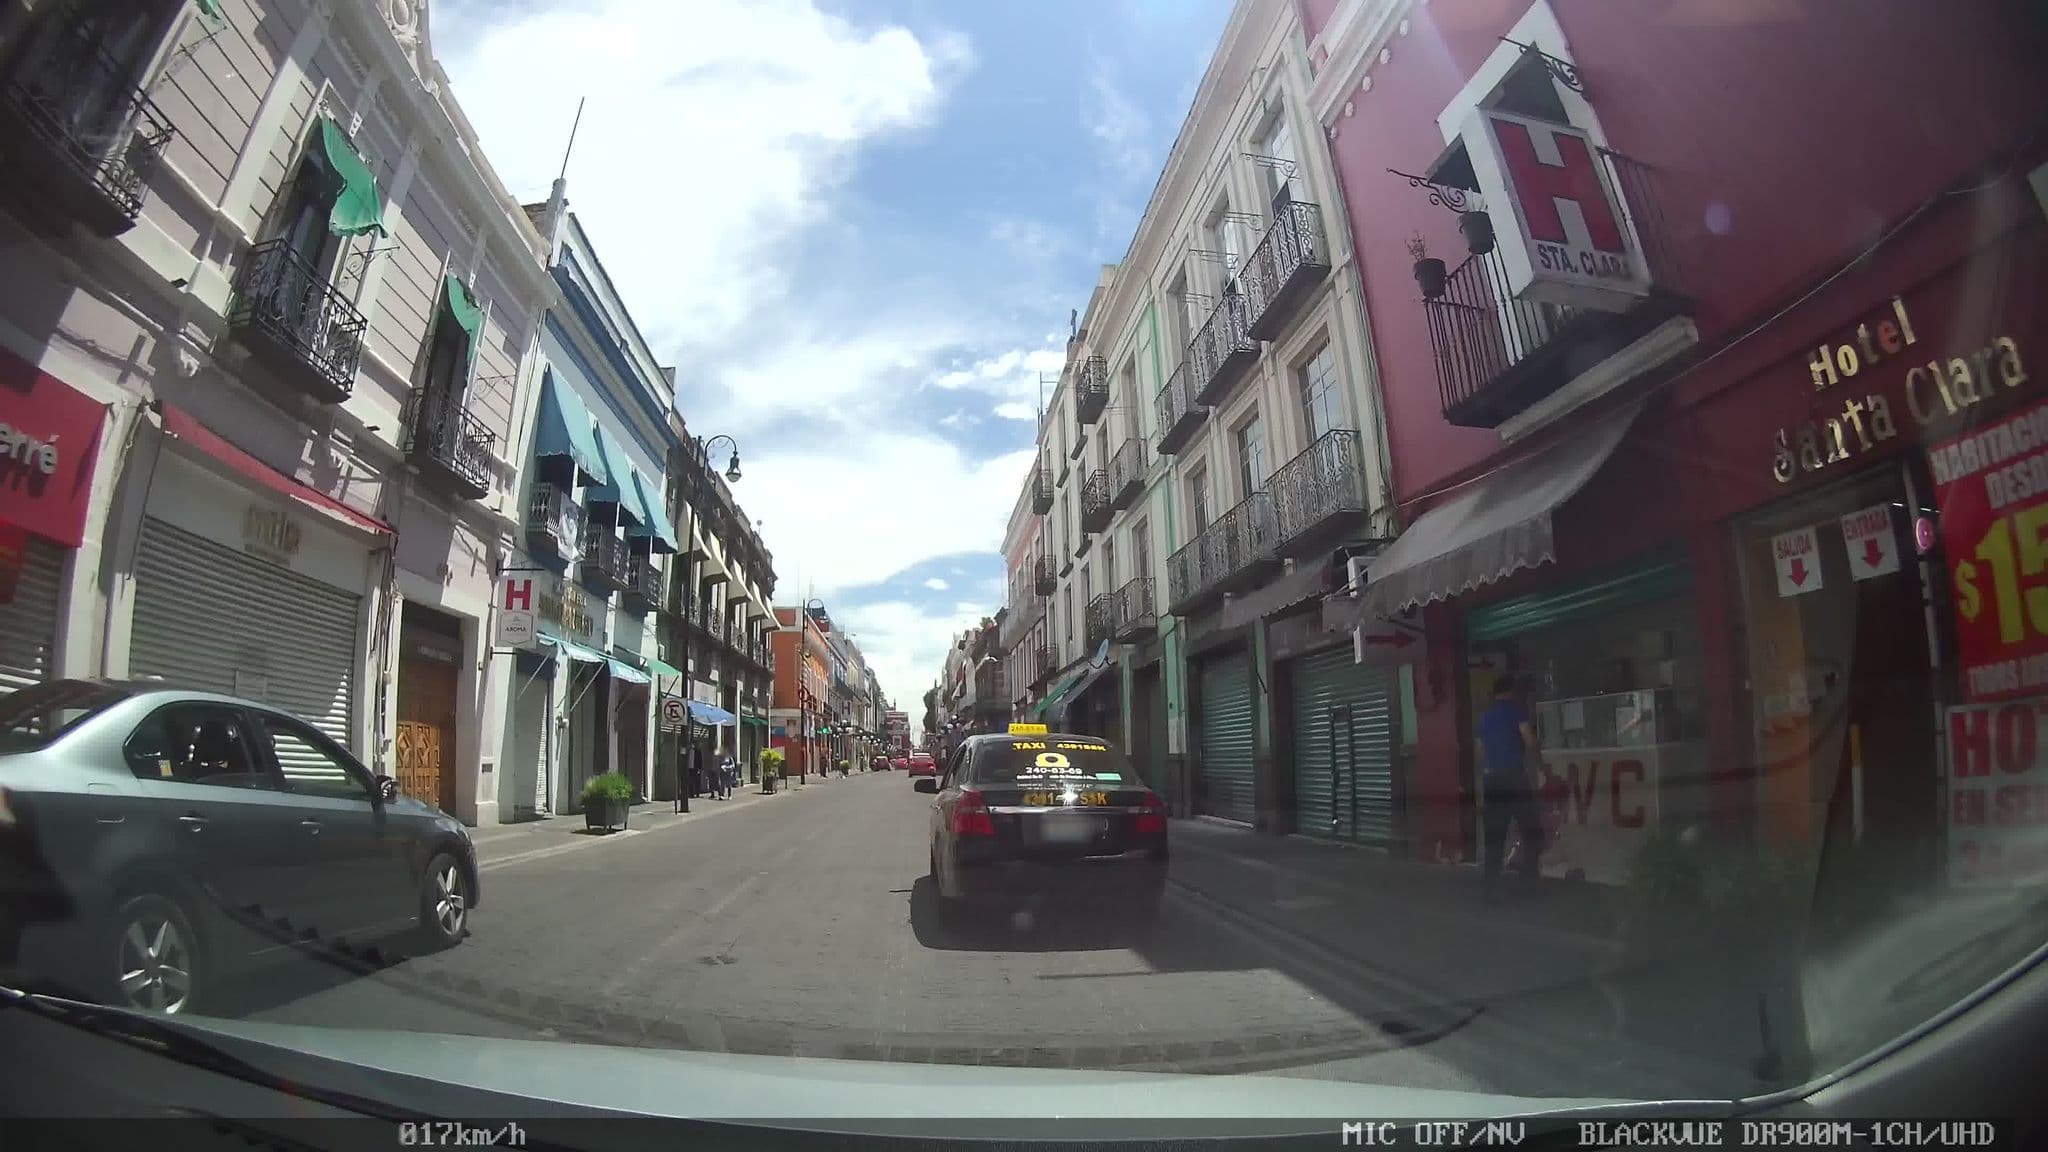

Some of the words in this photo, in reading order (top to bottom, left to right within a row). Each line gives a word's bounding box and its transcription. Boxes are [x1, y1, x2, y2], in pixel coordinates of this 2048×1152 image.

[1490, 117, 1626, 252] H
[1537, 244, 1578, 274] STA.
[1808, 296, 1917, 391] Hotel
[1772, 394, 1897, 482] Santa
[1906, 336, 2028, 424] Clara
[1776, 533, 1813, 560] SALIDA
[505, 579, 532, 610] H
[1013, 742, 1046, 750] TAXI
[1543, 759, 1646, 829] WC
